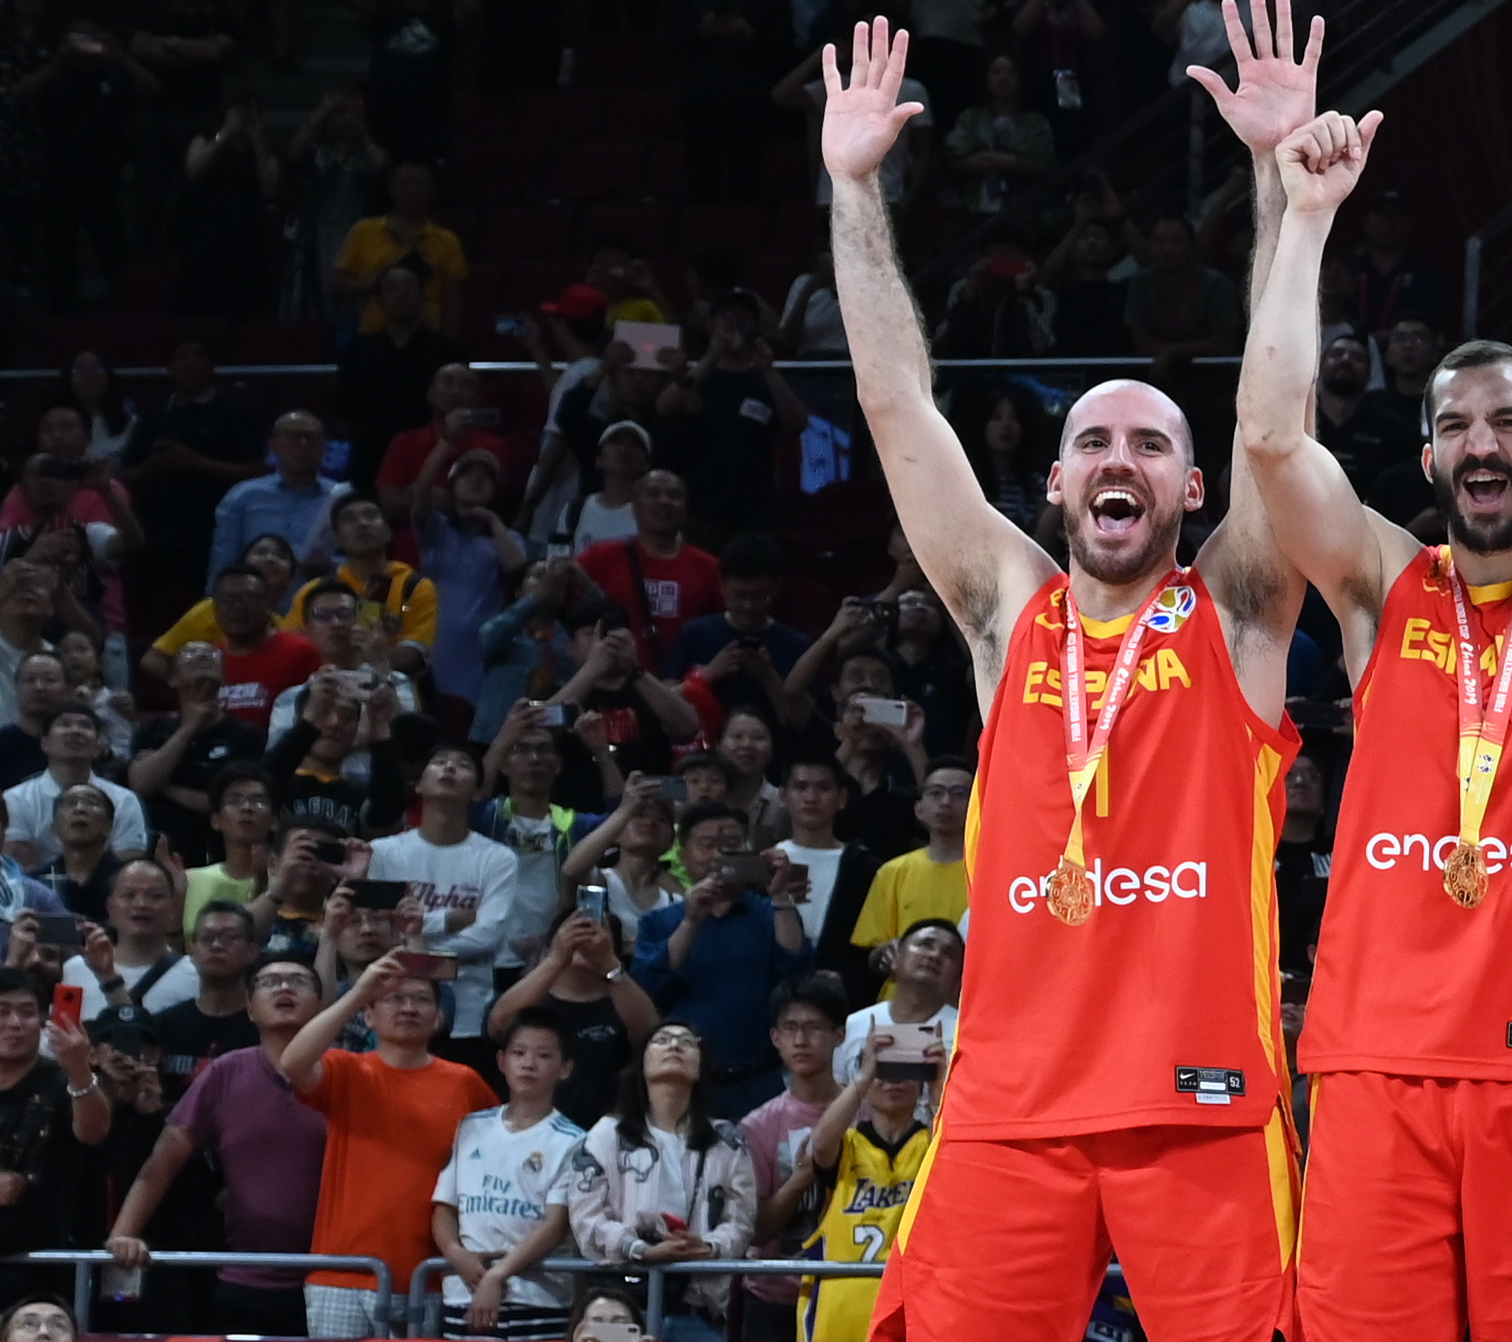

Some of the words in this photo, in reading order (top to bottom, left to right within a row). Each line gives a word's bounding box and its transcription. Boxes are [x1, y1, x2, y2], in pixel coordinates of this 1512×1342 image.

[1460, 642, 1475, 677] China
[1463, 678, 1478, 705] 2019
[1493, 692, 1507, 713] FIBA
[1229, 1076, 1241, 1089] 52
[458, 1192, 544, 1221] Emirates
